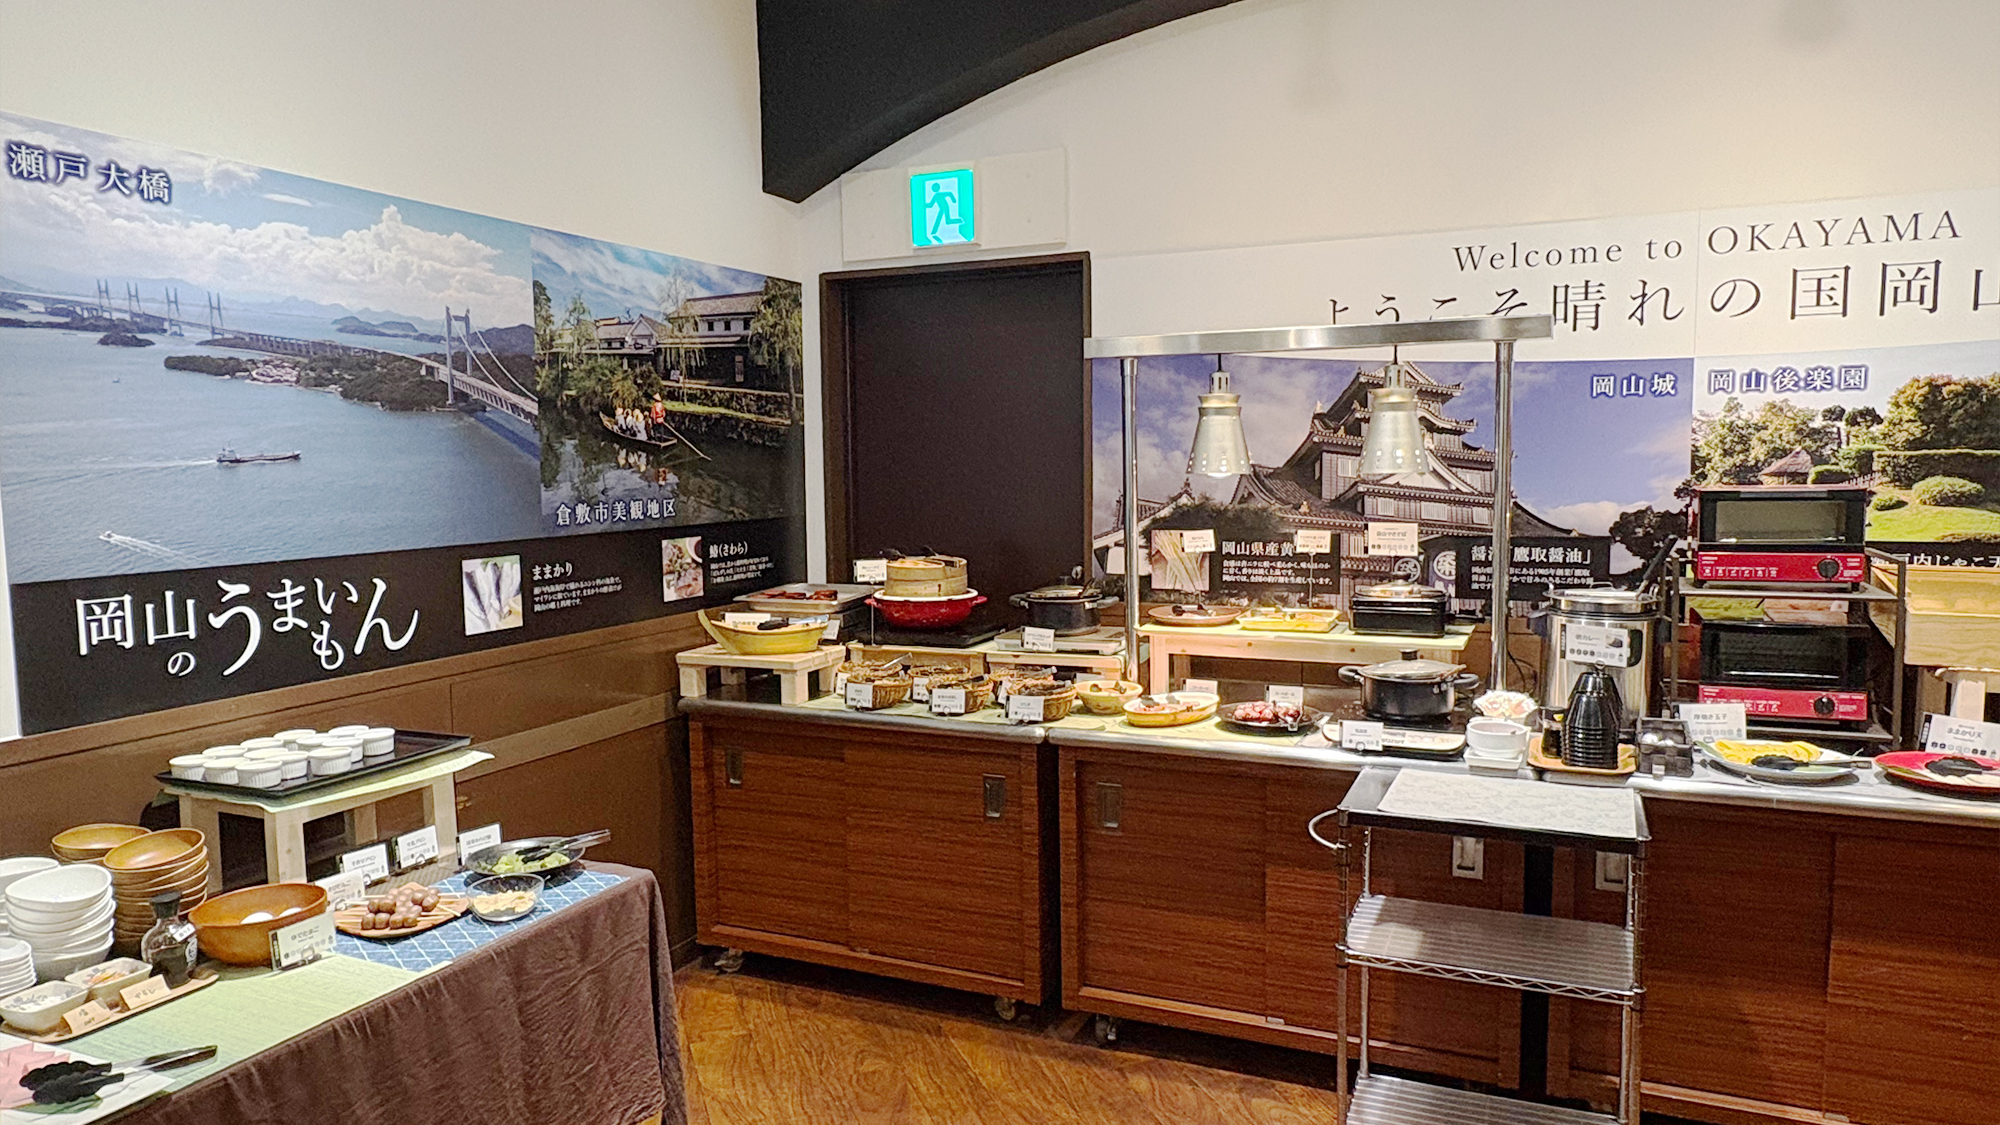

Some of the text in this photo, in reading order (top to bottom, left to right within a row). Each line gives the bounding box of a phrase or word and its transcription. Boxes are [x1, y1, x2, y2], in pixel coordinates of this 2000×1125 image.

[9, 143, 171, 203] 瀬戸大橋
[1452, 209, 1962, 273] Welcome to OKAYAMA
[1591, 372, 1677, 398] 岡山城
[1708, 366, 1868, 394] 岡山後楽園
[556, 499, 677, 526] 倉敷市美観地区
[1222, 540, 1296, 557] 岡山県産黄
[532, 562, 573, 581] ままかり
